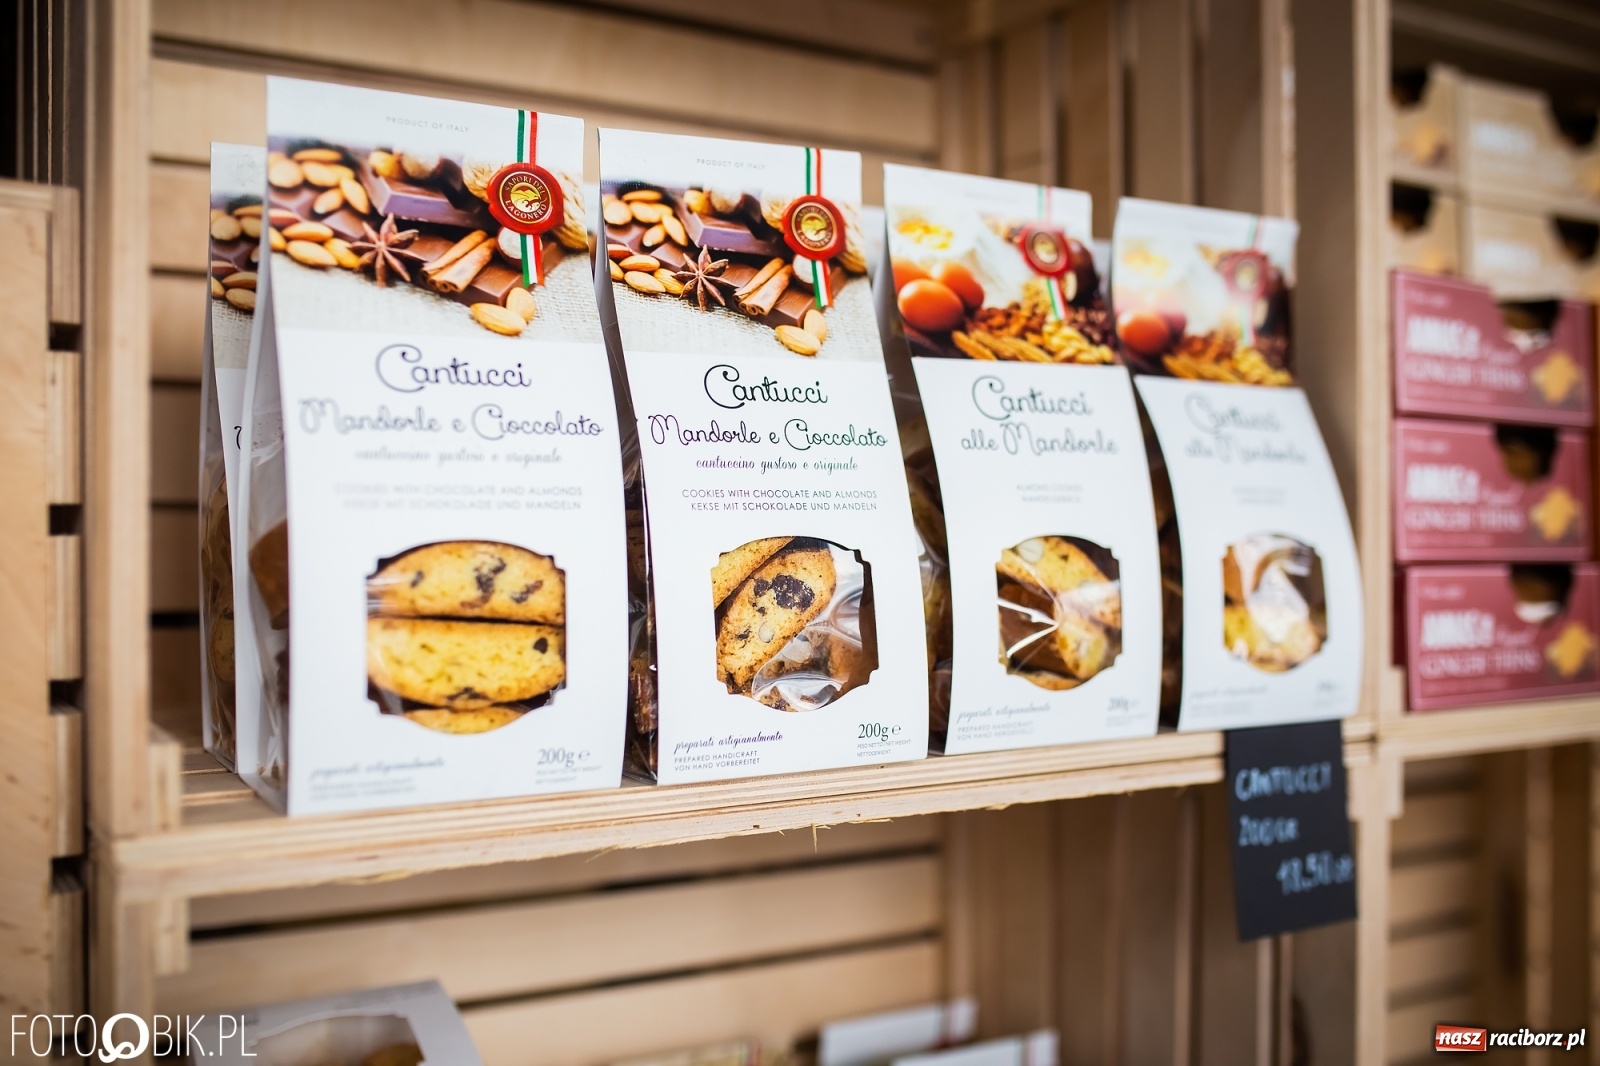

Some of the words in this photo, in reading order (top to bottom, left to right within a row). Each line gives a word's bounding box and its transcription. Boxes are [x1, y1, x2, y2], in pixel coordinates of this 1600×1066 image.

[446, 124, 469, 132] ITALY
[696, 158, 732, 167] PRODUCT
[505, 176, 532, 191] SAPORI
[533, 180, 546, 195] DEL
[505, 198, 547, 220] LAGONERO
[375, 343, 532, 393] Cantucci
[704, 364, 828, 409] Cantucci
[972, 375, 1094, 421] Cantucci
[298, 397, 442, 435] Mandorle
[452, 417, 466, 433] e
[472, 403, 604, 441] Cioccolato
[647, 414, 762, 446] Mandorle
[769, 431, 780, 444] e
[784, 418, 888, 451] Cioccolato
[961, 428, 999, 451] alle
[1000, 422, 1118, 456] Mandorle
[696, 456, 755, 469] cantuccino
[761, 457, 798, 474] gustoso
[803, 461, 809, 470] e
[814, 457, 858, 475] originale
[682, 489, 725, 498] COOKIES
[727, 490, 750, 498] WITH
[753, 489, 810, 499] CHOCOLATE
[812, 490, 832, 499] AND
[835, 490, 877, 499] ALMONDS
[691, 502, 720, 511] KEKSE
[724, 502, 739, 511] MIT
[742, 502, 808, 511] SCHOKOLADE
[810, 503, 830, 511] UND
[834, 503, 877, 511] MANDELN
[674, 735, 716, 755] preparati
[718, 730, 784, 749] artigianalmente
[858, 722, 889, 742] 200g
[537, 746, 575, 769] 200g
[674, 754, 710, 764] PREPARED
[712, 750, 758, 761] HANDICRAFT
[674, 763, 692, 772] VON
[692, 762, 714, 770] HAND
[716, 757, 760, 768] VORBEREITET
[1236, 762, 1331, 800] CANTUCCI
